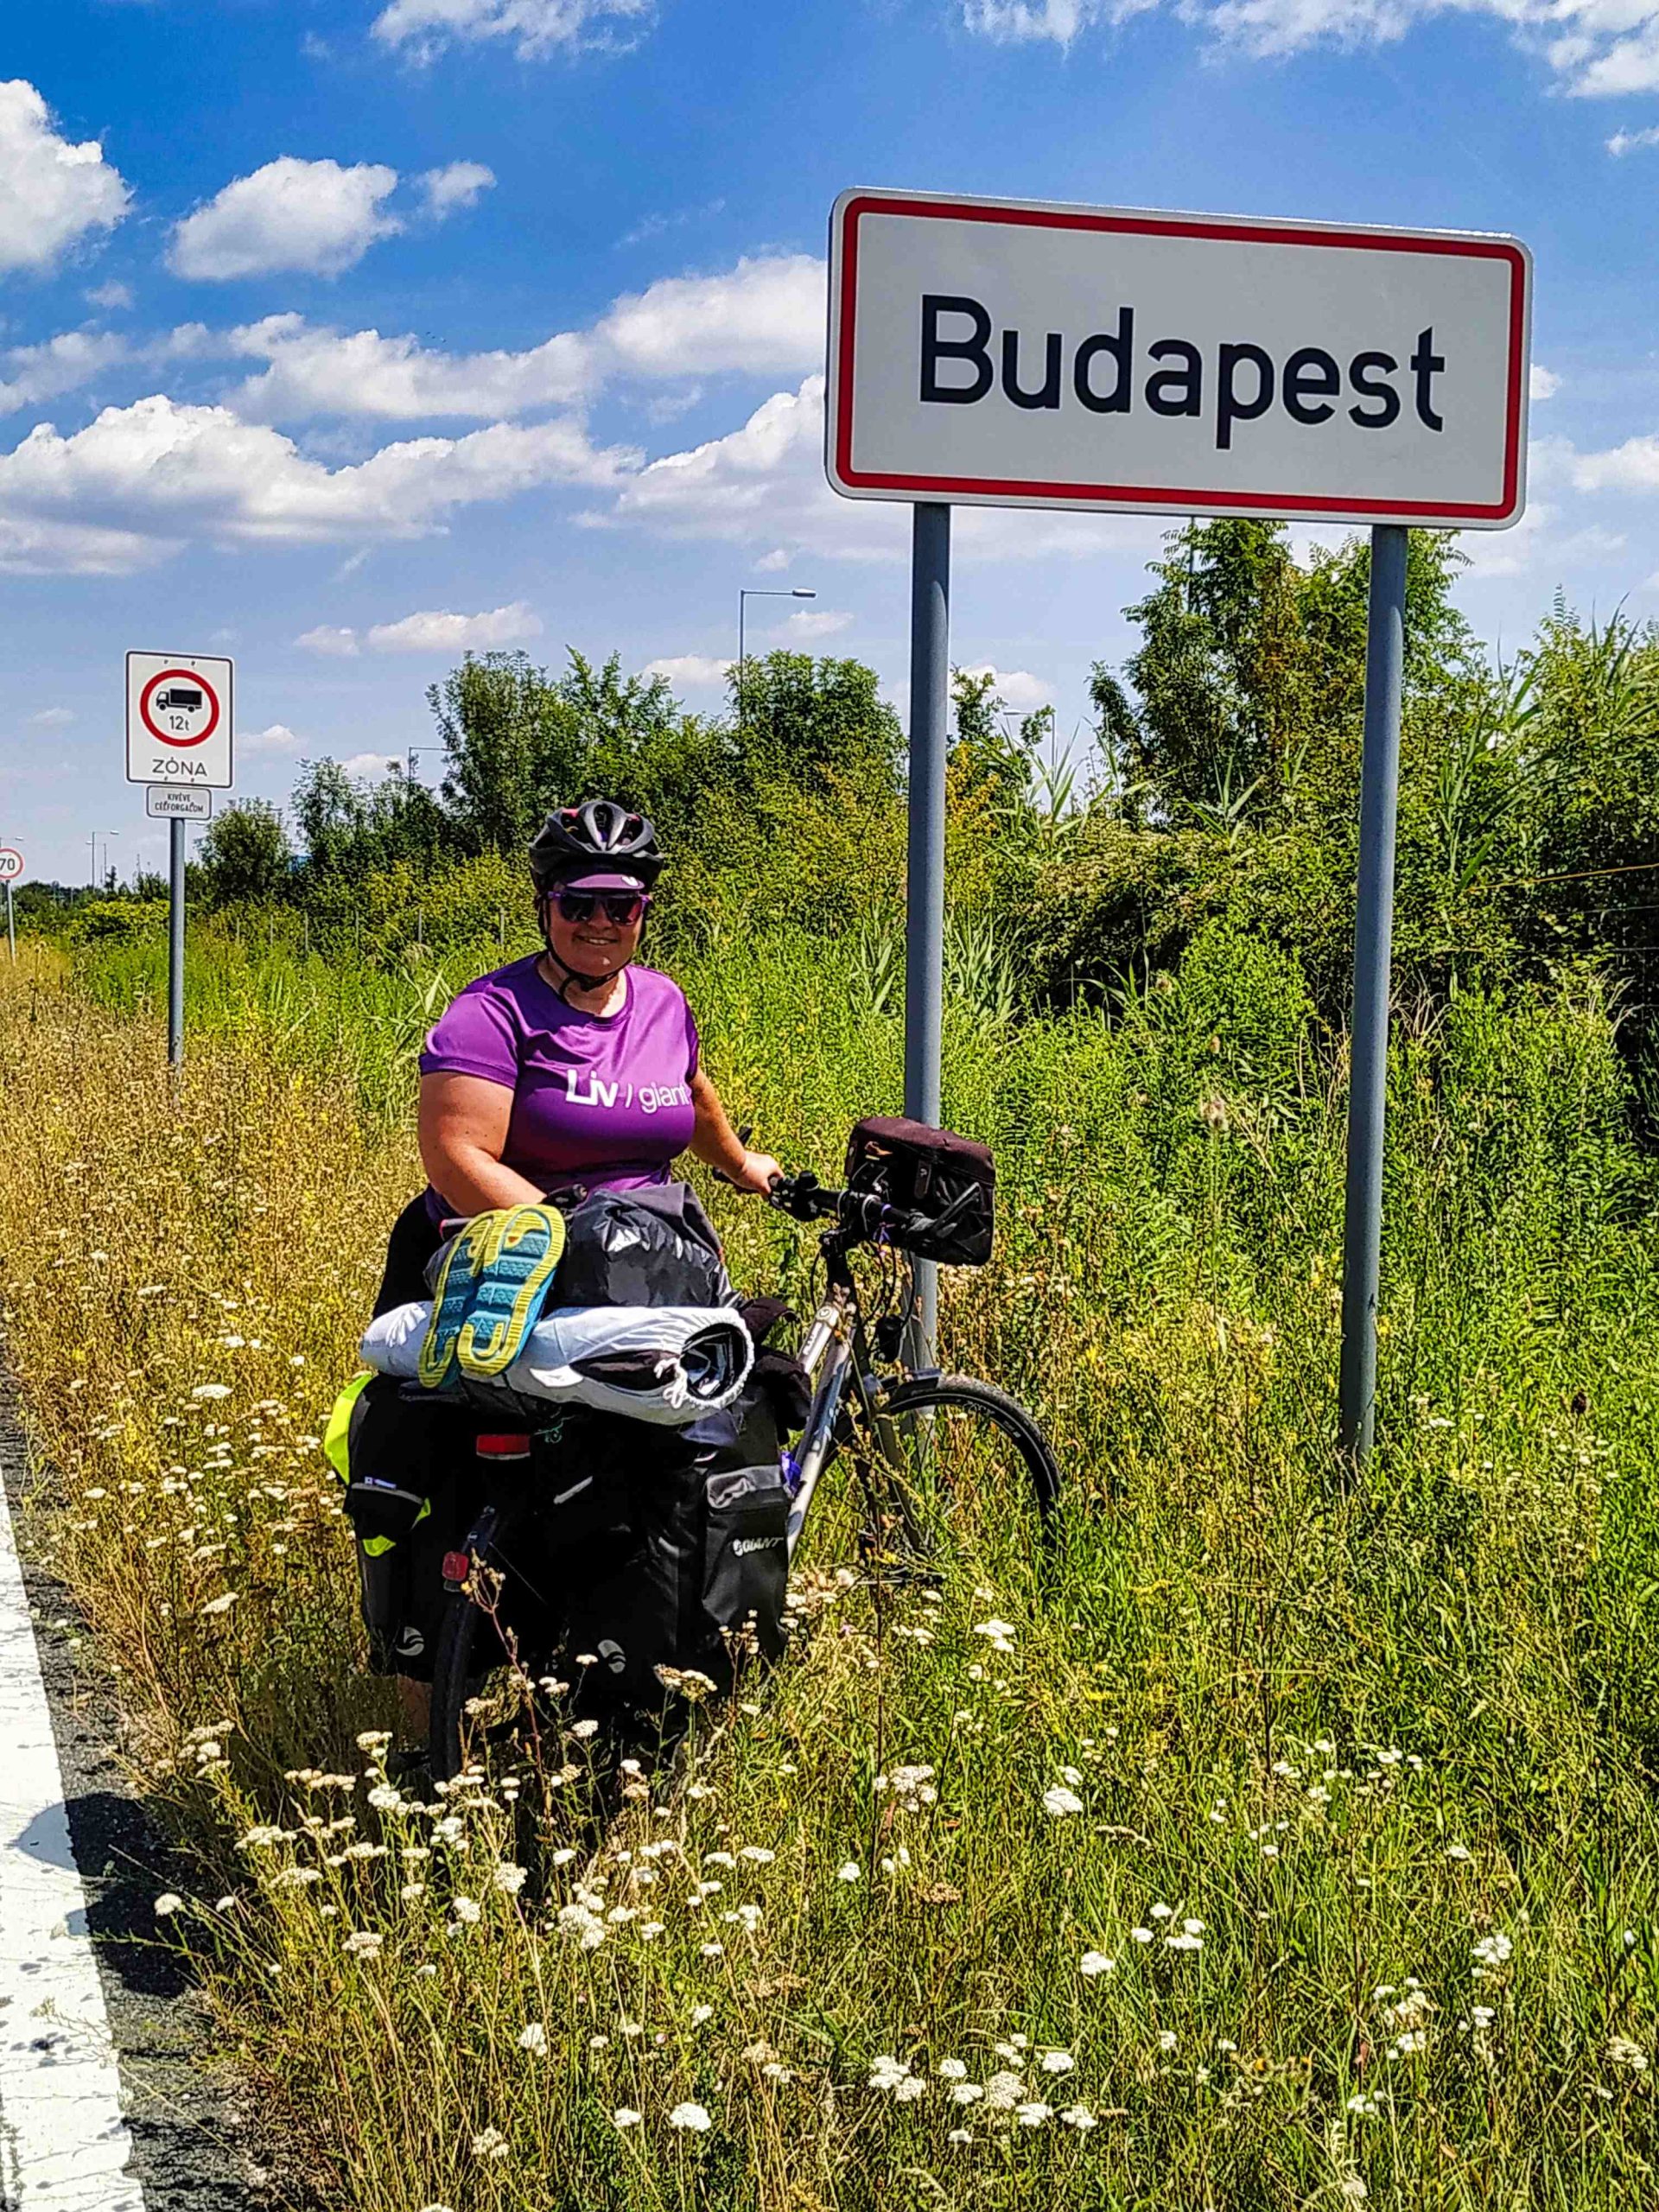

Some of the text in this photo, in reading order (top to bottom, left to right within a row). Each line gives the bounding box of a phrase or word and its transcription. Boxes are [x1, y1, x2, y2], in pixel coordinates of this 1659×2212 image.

[919, 294, 1446, 450] Budapest
[168, 715, 189, 732] 12t
[152, 757, 207, 777] ZÓNA
[167, 791, 191, 802] KIVÉVE
[0, 858, 16, 871] 70
[565, 1069, 619, 1108] Liv
[639, 1082, 690, 1114] giant
[743, 1537, 784, 1553] GIANT
